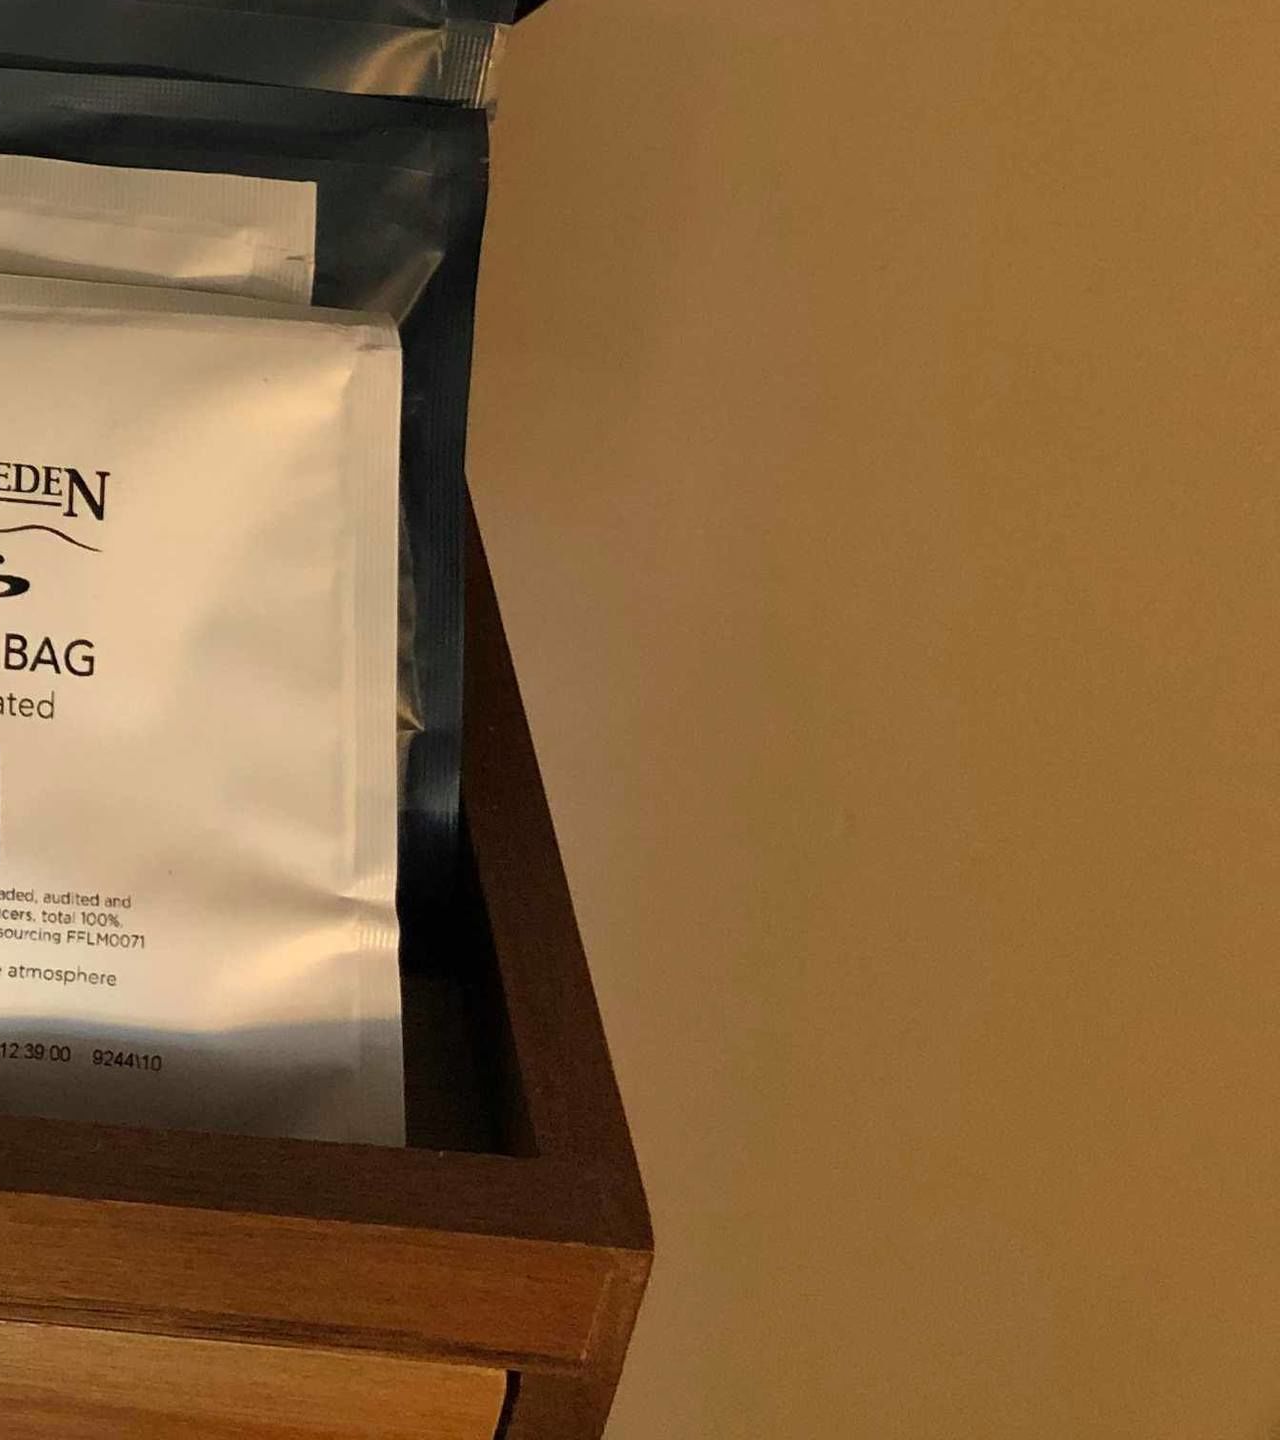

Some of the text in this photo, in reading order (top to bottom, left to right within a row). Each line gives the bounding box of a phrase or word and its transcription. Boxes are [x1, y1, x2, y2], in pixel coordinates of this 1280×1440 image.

[3, 633, 95, 678] BAG
[43, 891, 100, 908] audited
[104, 895, 132, 909] and
[41, 910, 76, 924] total
[7, 962, 118, 987] atmosphere
